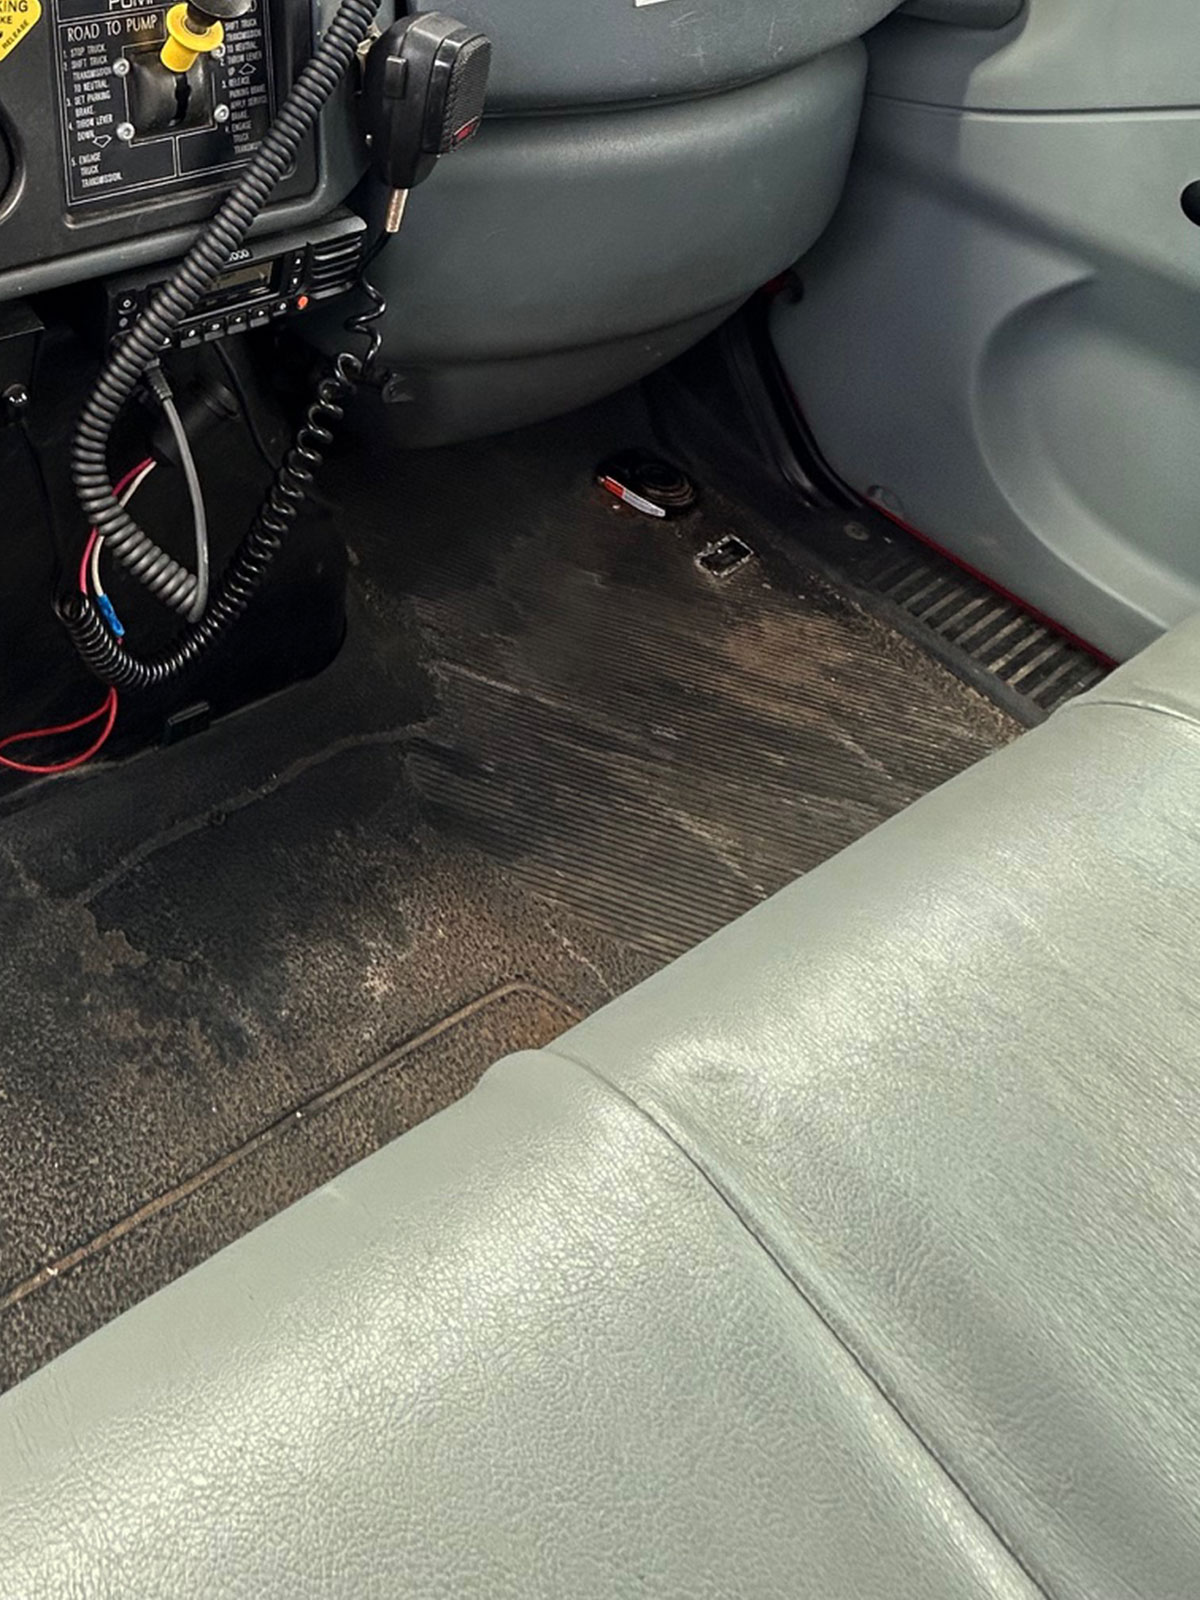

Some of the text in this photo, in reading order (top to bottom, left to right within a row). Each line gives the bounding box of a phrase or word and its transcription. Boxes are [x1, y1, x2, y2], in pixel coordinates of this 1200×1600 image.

[67, 14, 159, 42] ROAD TO PUMP
[86, 89, 111, 103] PARKING
[96, 113, 113, 126] LEVER
[79, 151, 102, 166] ENGAGE
